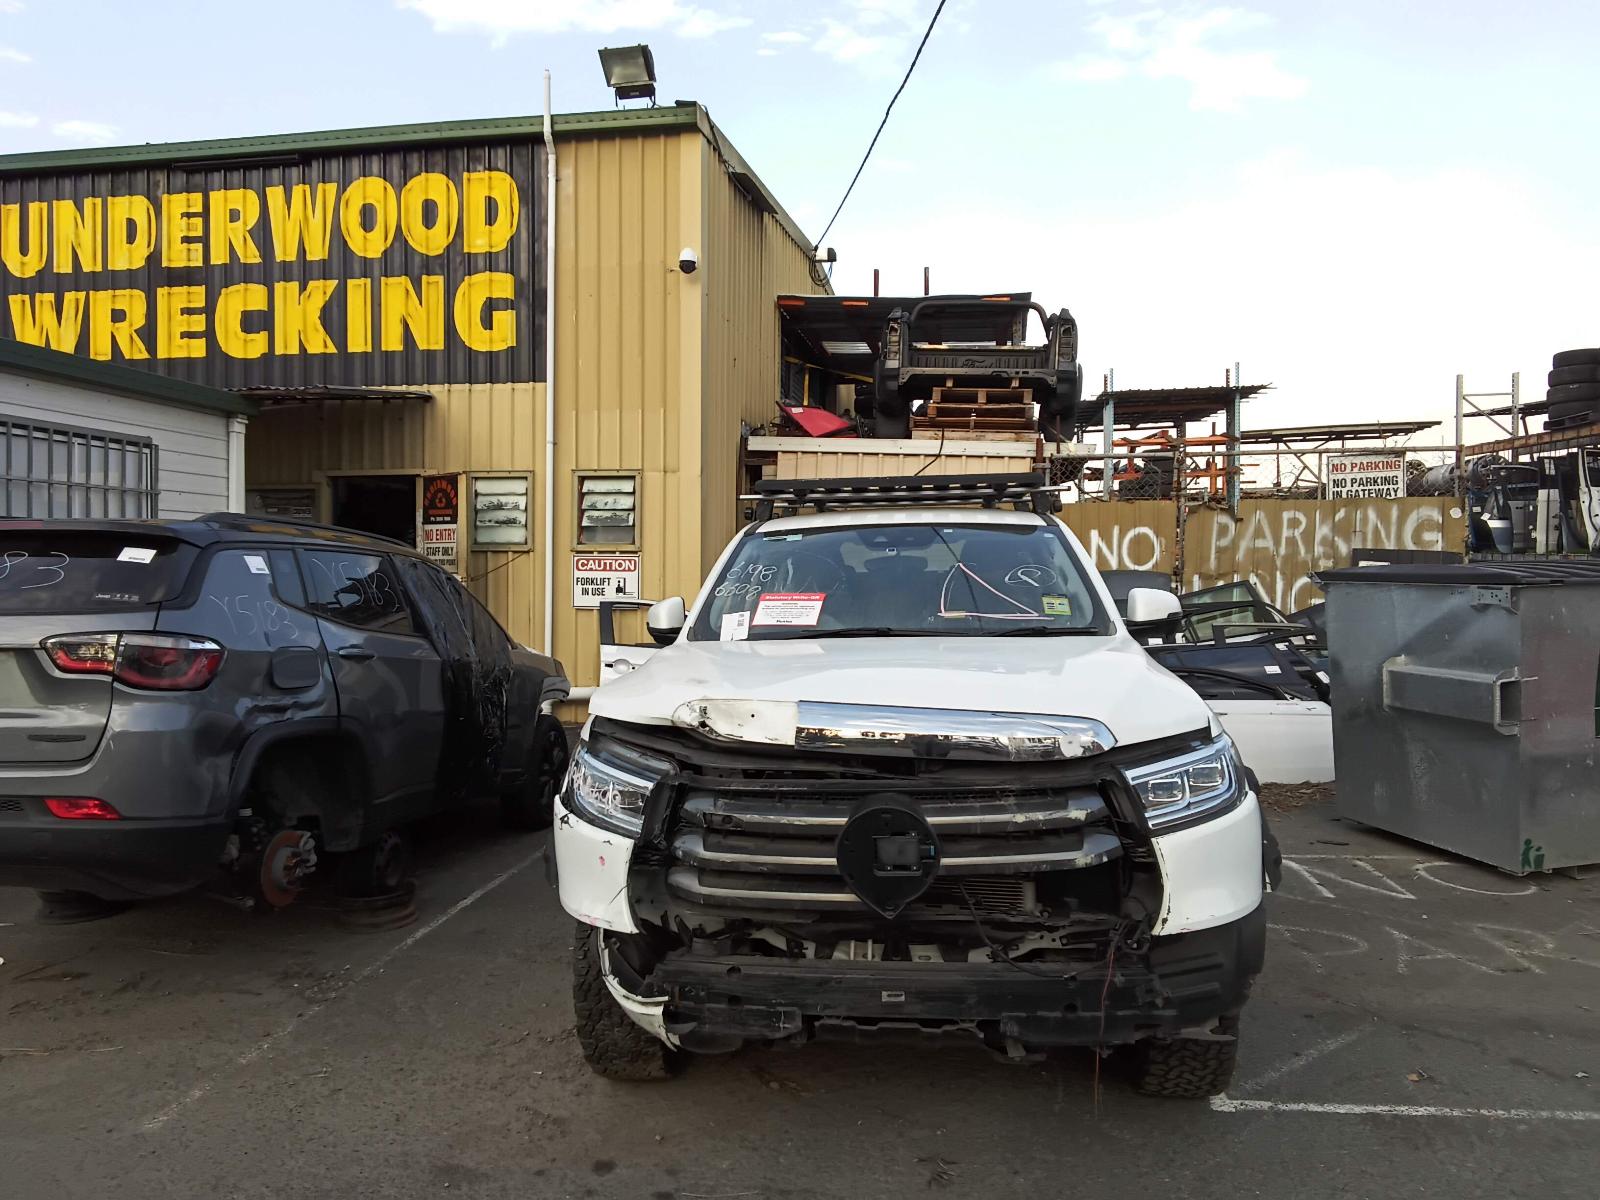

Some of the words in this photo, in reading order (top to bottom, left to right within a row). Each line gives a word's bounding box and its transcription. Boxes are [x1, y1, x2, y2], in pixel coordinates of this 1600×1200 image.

[1, 171, 520, 278] UNDERWOOD
[9, 271, 517, 360] WRECKING
[1332, 463, 1346, 472] NO
[1350, 460, 1401, 472] PARKING
[1333, 478, 1346, 488] NO
[1350, 475, 1398, 487] PARKING
[1333, 490, 1342, 500] IN
[1346, 487, 1399, 499] GATEWAY
[425, 530, 433, 541] NO
[435, 528, 456, 541] ENTRY
[1091, 525, 1160, 571] NO
[1210, 507, 1443, 572] PARKING
[426, 547, 440, 556] STAFF
[442, 547, 454, 556] ONLY
[578, 559, 635, 570] CAUTION
[576, 577, 611, 586] FORKLIFT
[581, 588, 589, 596] IN
[591, 588, 606, 596] USE
